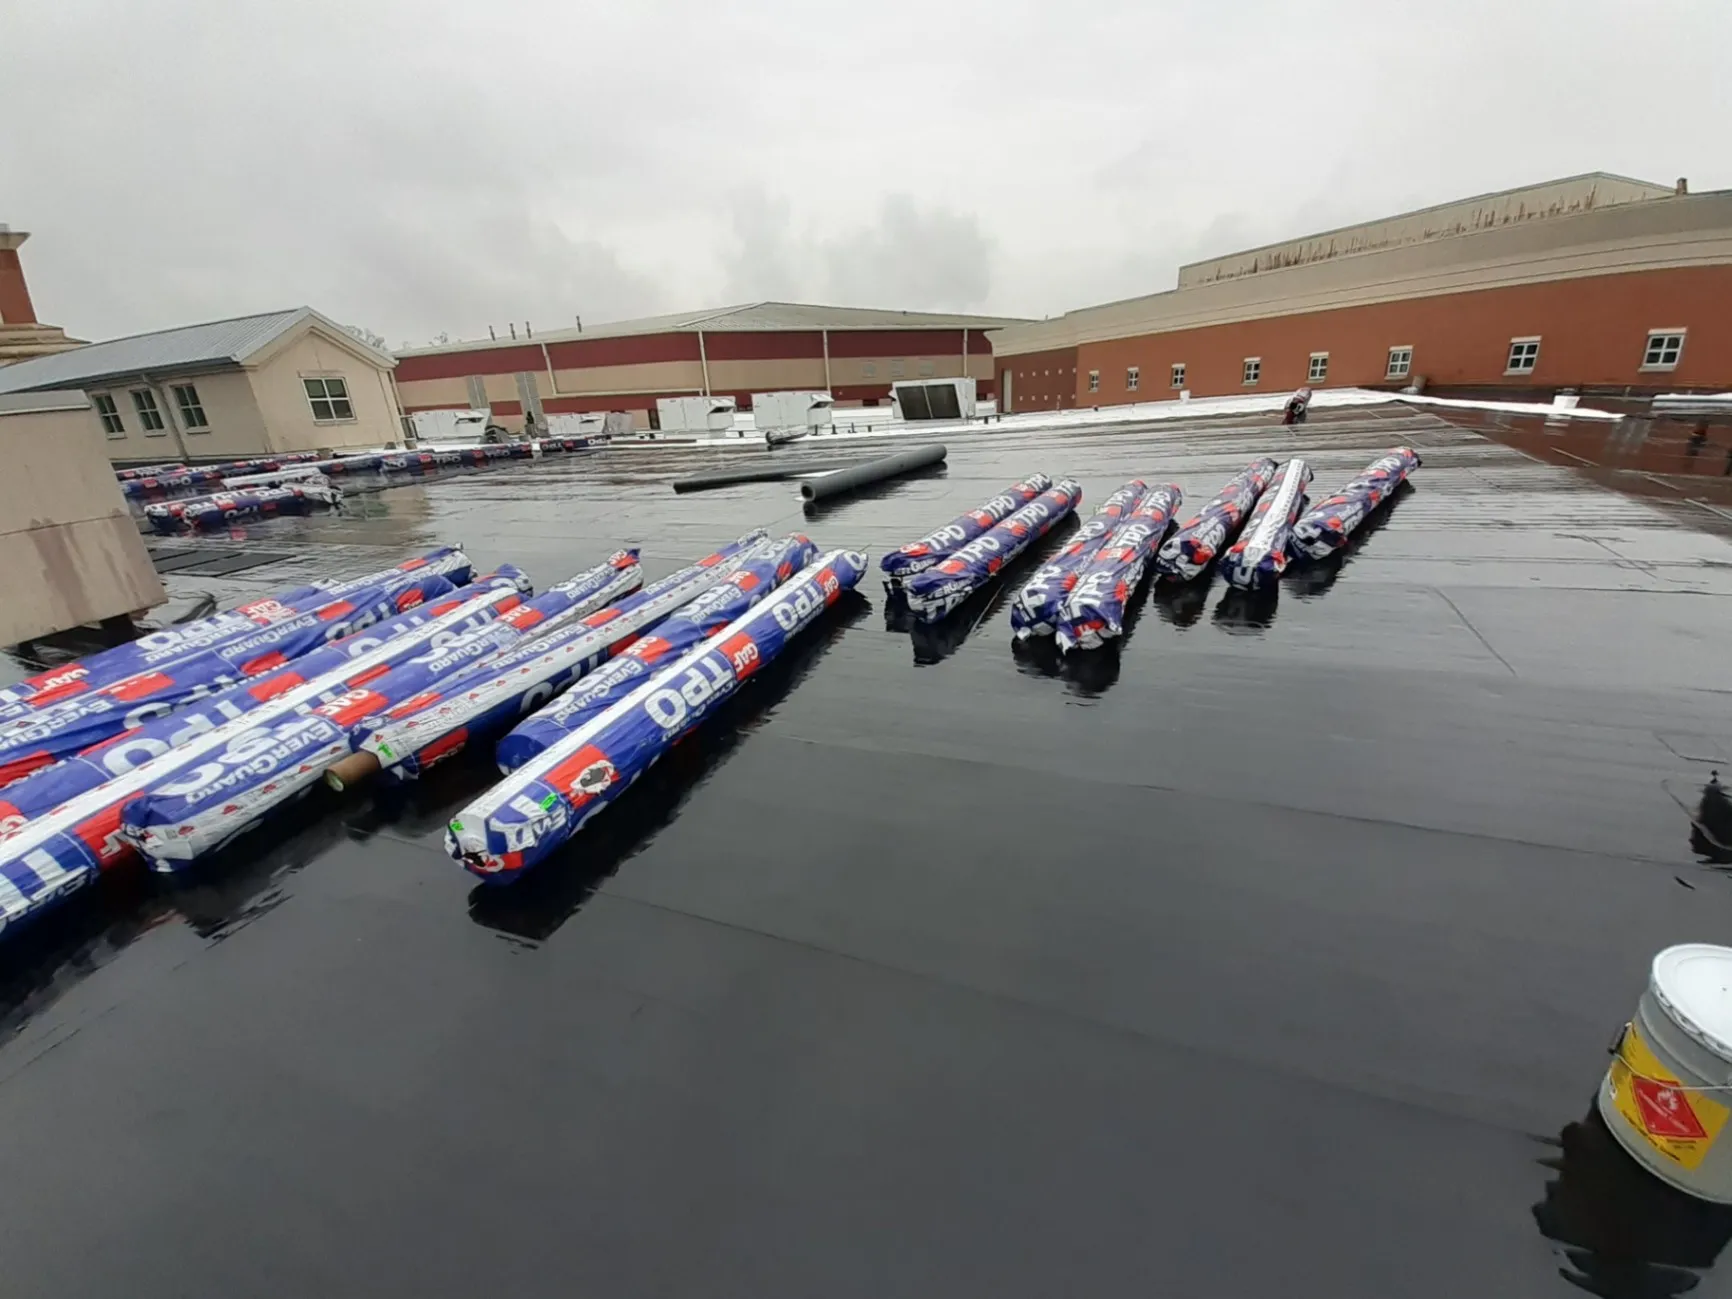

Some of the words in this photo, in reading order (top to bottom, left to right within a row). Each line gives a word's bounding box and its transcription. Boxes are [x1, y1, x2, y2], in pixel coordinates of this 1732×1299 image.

[1027, 473, 1050, 491] TPO
[983, 495, 1016, 519] TPO
[1017, 502, 1049, 527] TPO
[927, 524, 966, 551] TPO
[955, 536, 1000, 563] TPO
[1116, 523, 1150, 548] TPO
[823, 575, 840, 596] GAF
[771, 581, 825, 632] TPO
[221, 614, 318, 658] EVERGUARD
[491, 623, 587, 670] EVERGUARD
[733, 642, 760, 672] GAF
[554, 660, 644, 725] EVERGUARD
[645, 656, 734, 729] TPO
[186, 720, 337, 804] EVERGUARD
